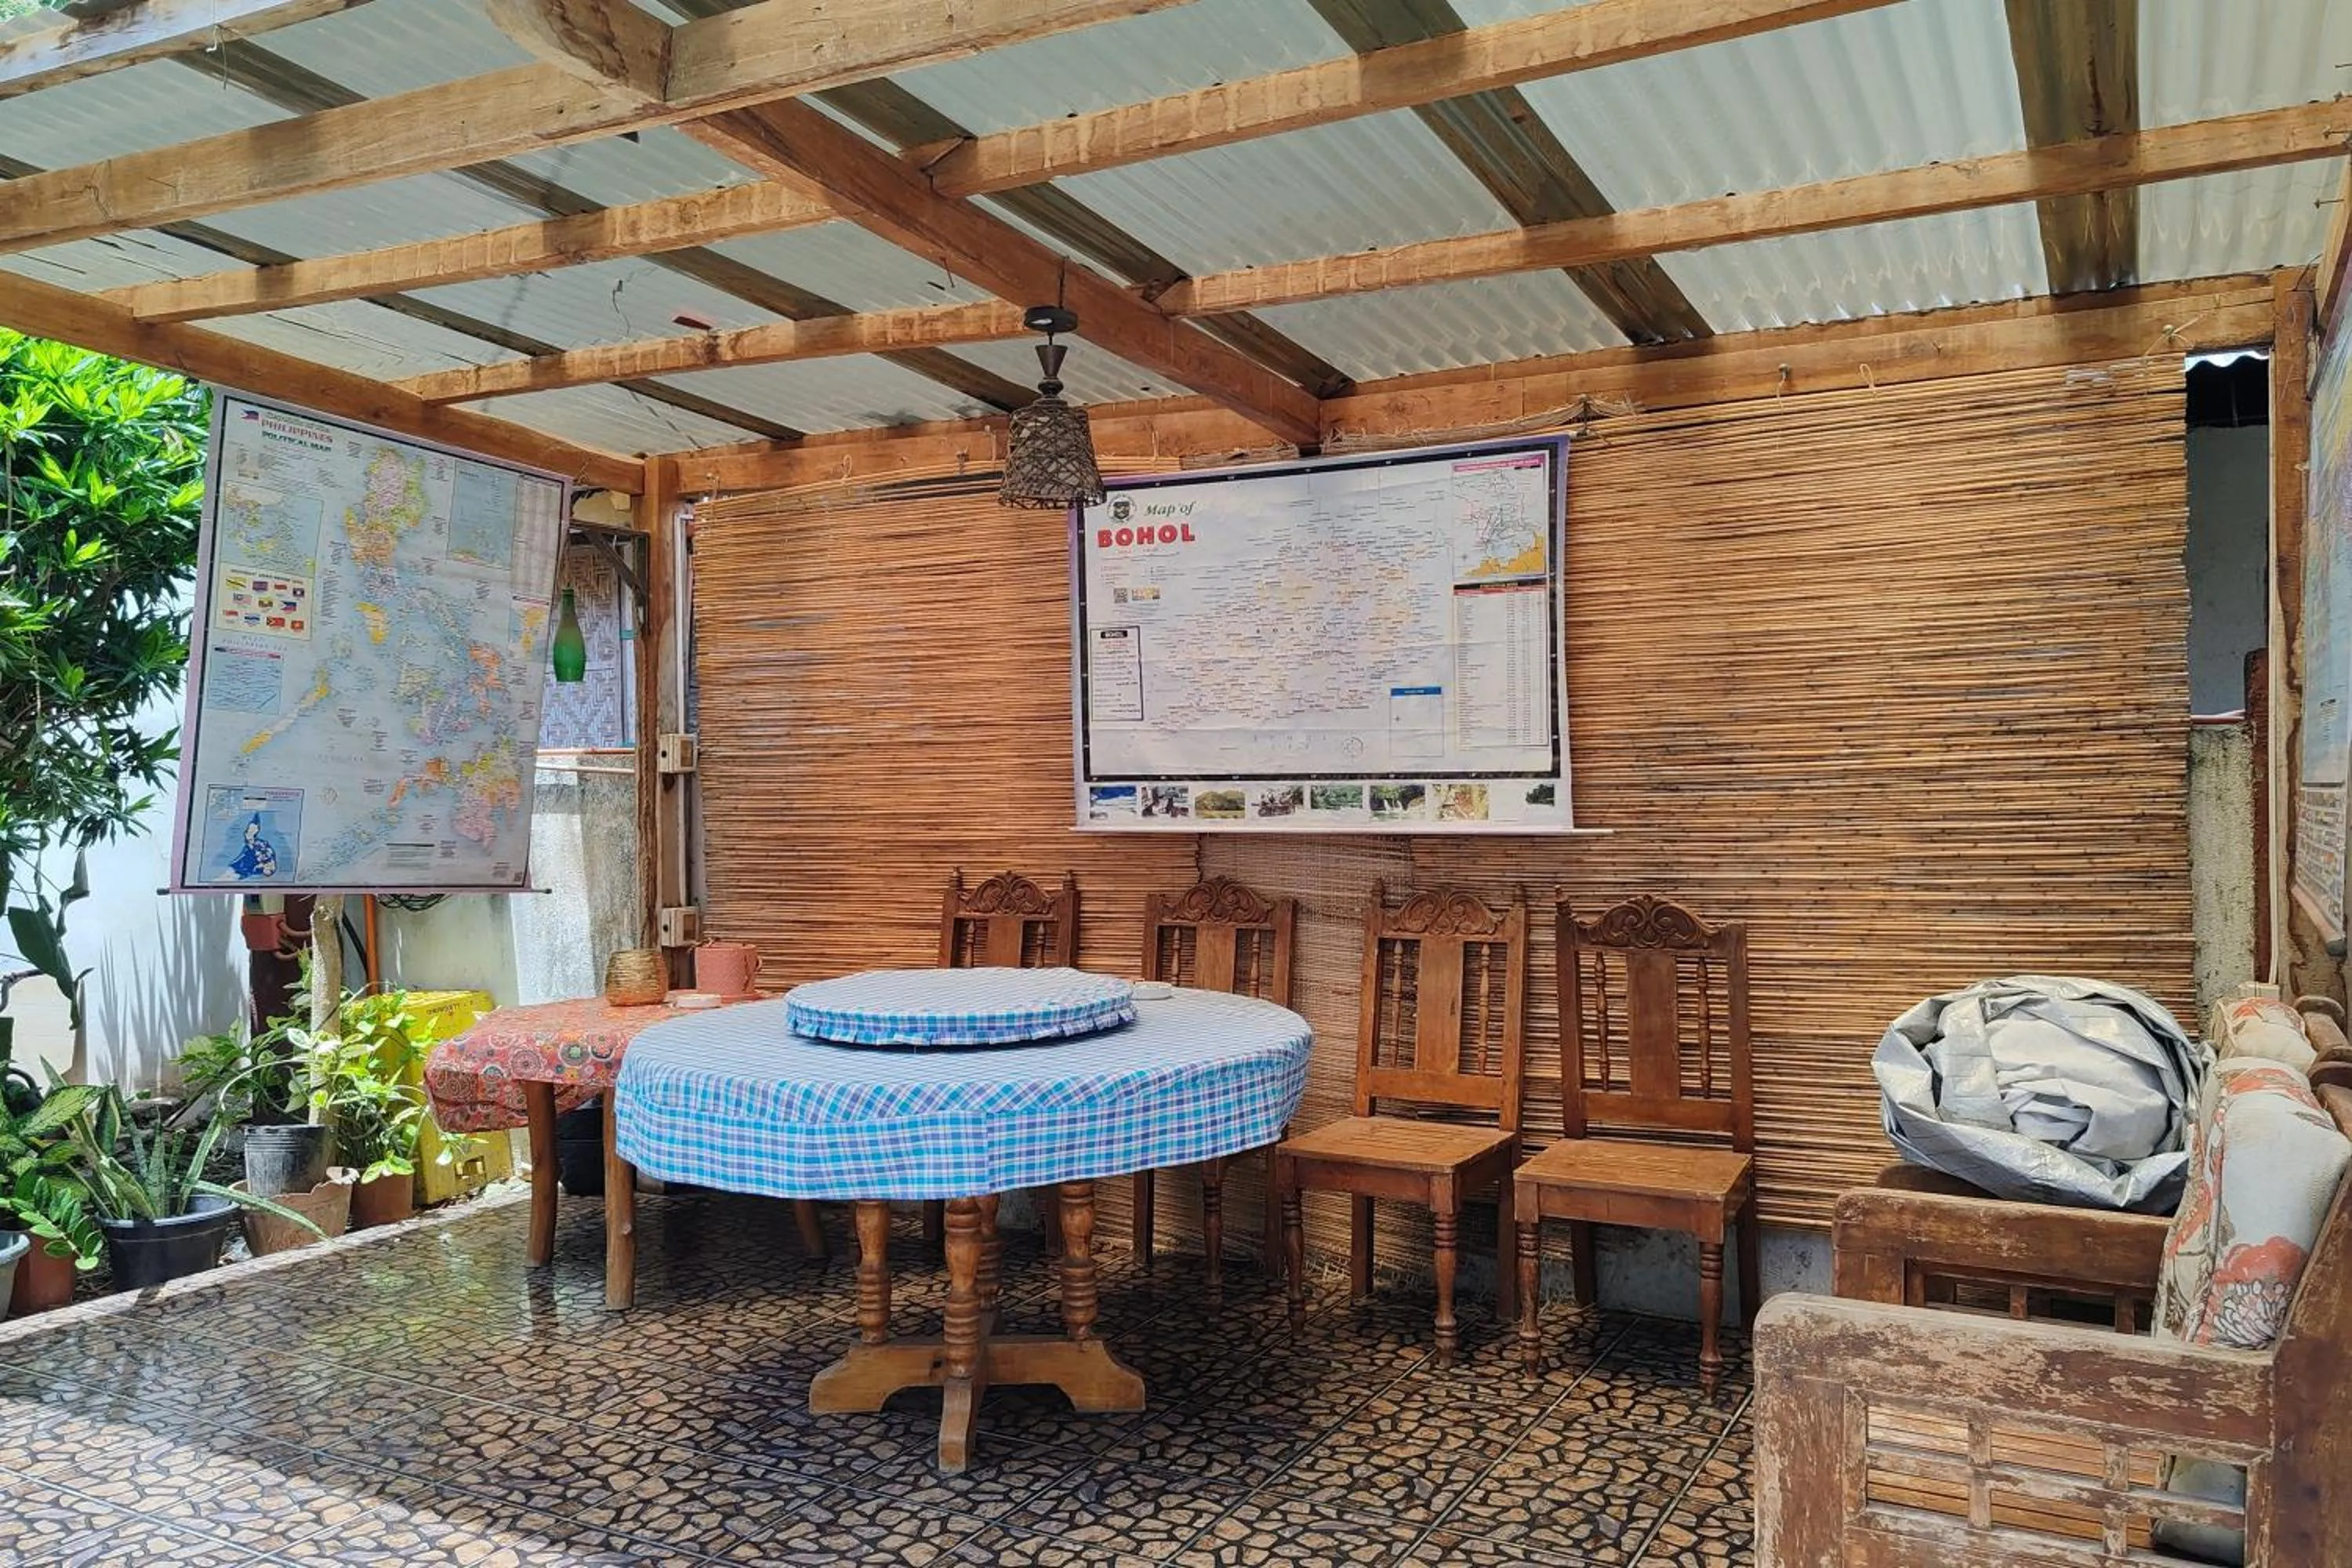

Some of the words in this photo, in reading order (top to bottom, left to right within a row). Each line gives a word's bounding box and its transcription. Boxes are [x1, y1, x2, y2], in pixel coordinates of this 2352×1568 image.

[1144, 504, 1175, 517] Map
[1179, 502, 1196, 515] of
[1097, 523, 1196, 548] BOHOL
